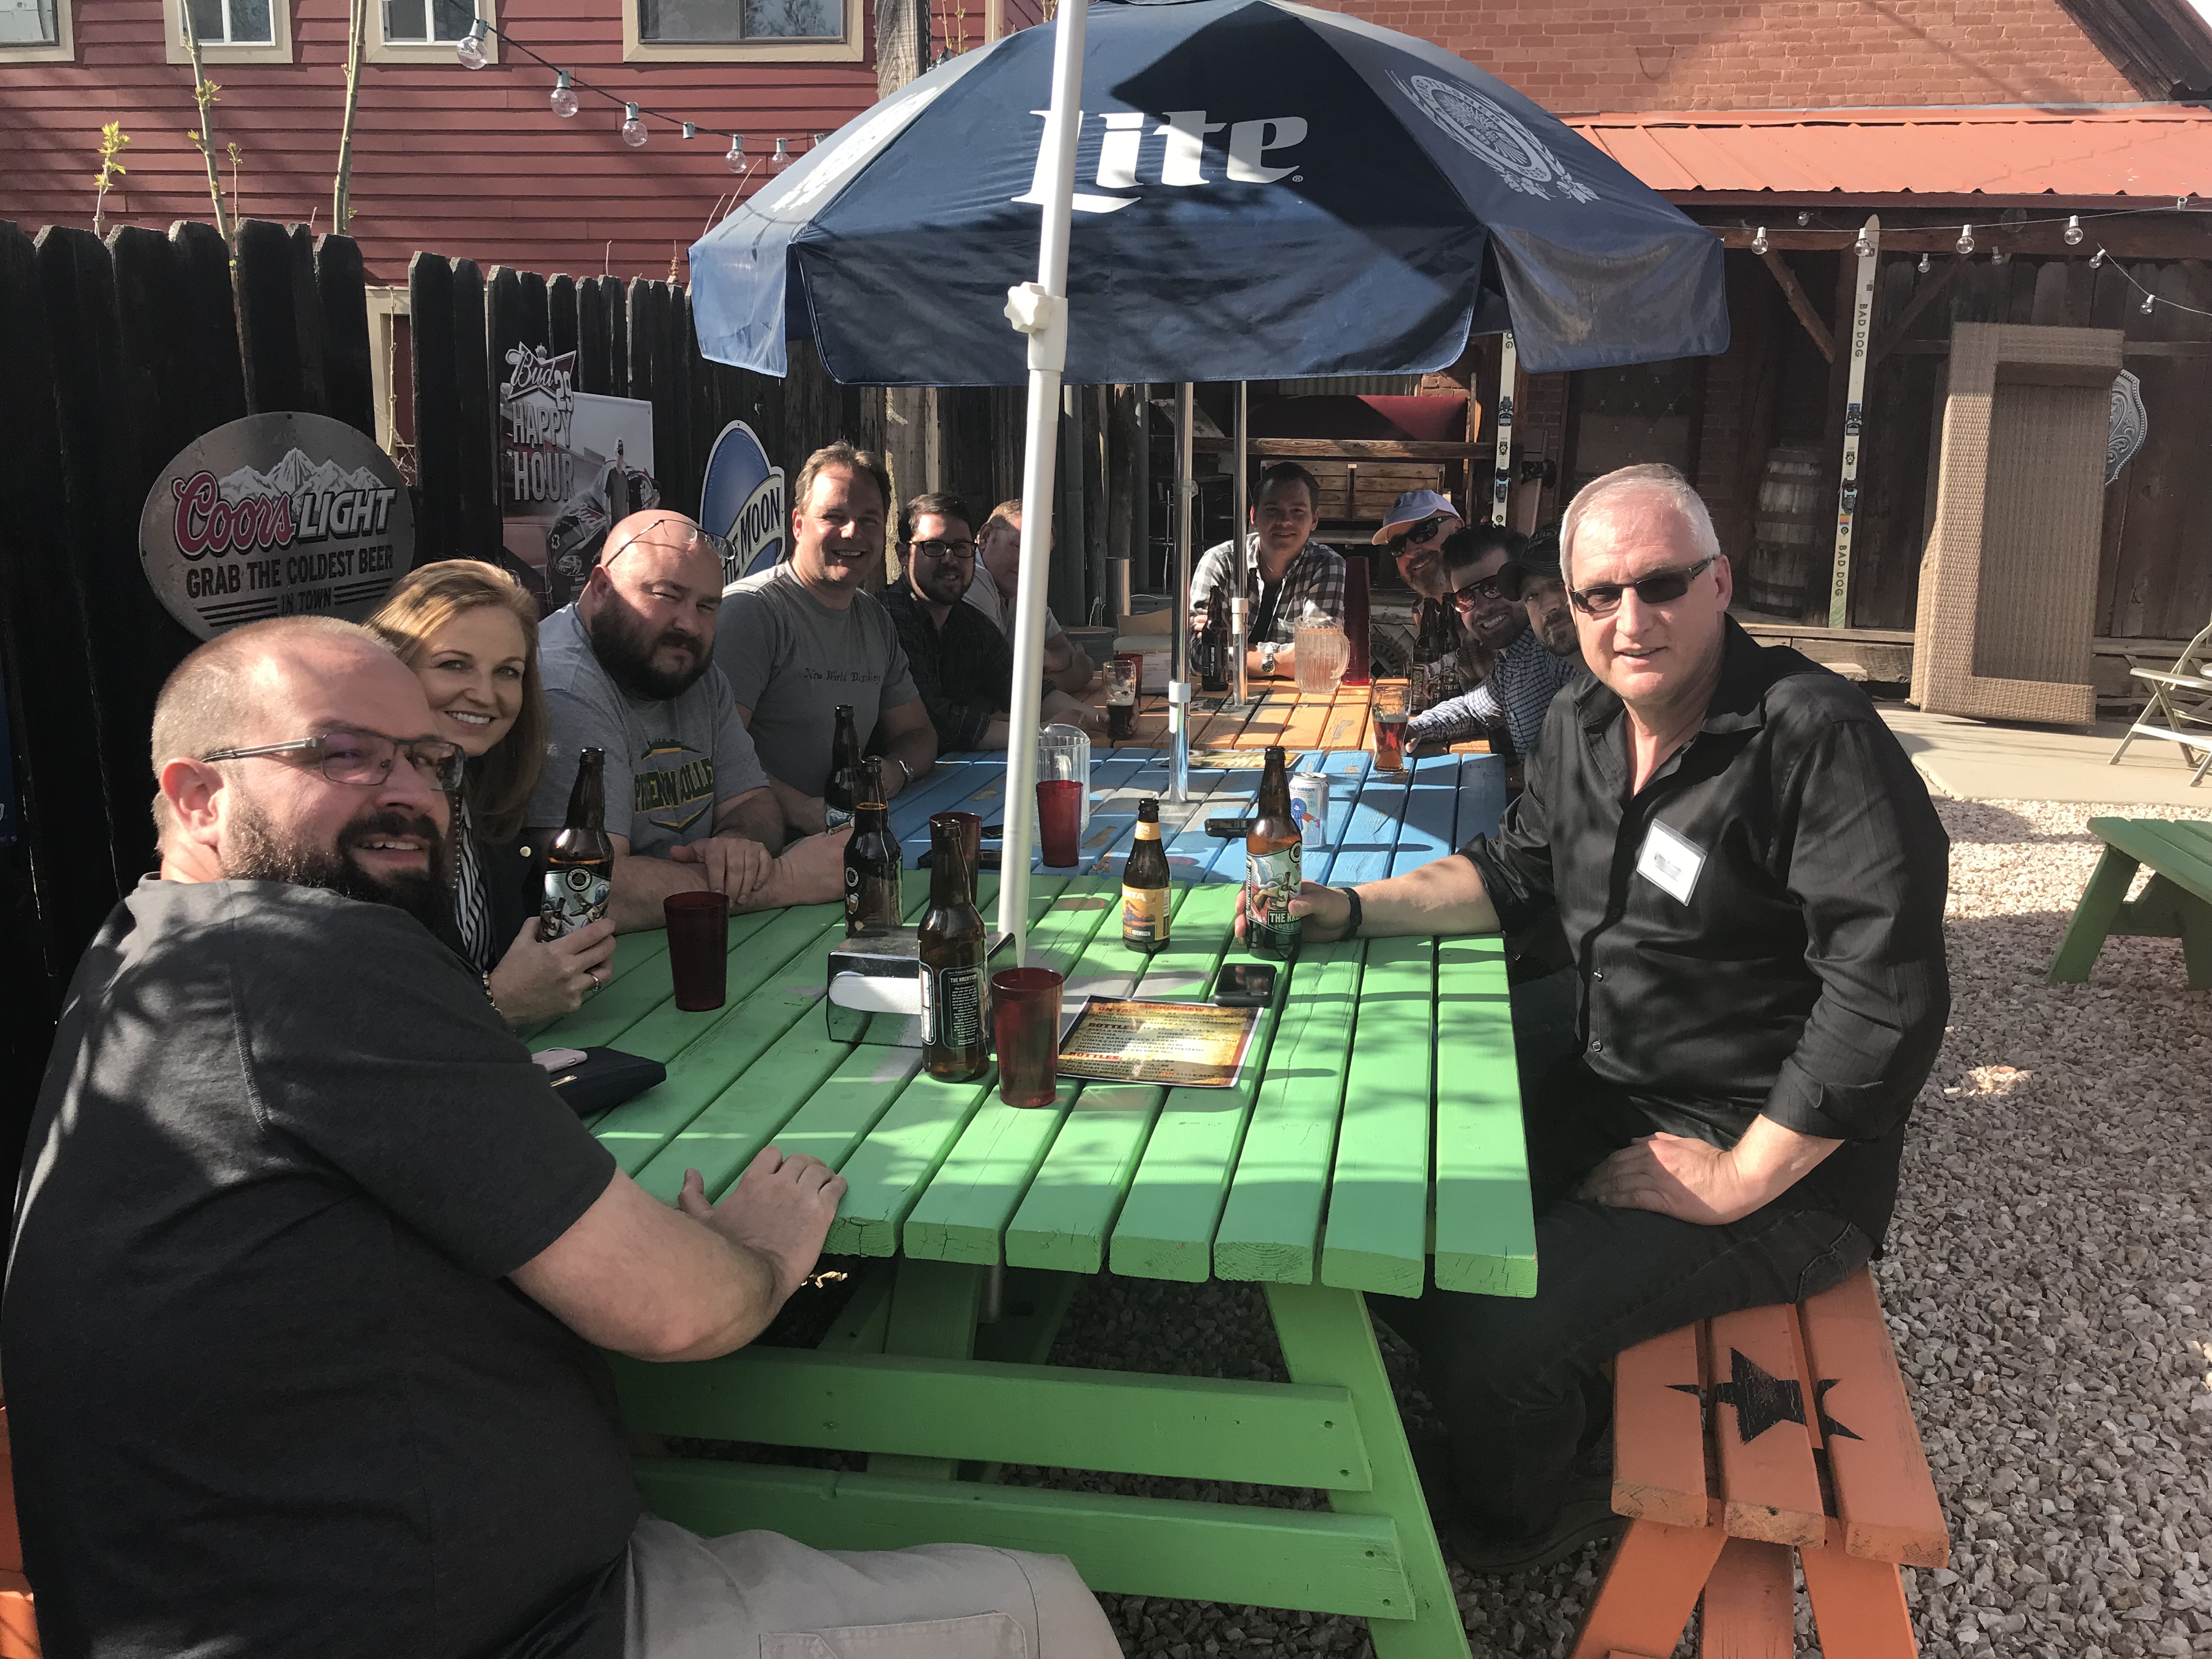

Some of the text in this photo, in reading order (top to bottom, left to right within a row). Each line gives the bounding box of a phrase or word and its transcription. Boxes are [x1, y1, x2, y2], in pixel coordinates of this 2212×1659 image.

[1011, 110, 1308, 213] Lite
[1505, 332, 1514, 349] OG
[1854, 303, 1868, 357] BAD DOG
[505, 348, 574, 412] Bud 29
[512, 402, 572, 449] HAPPY
[514, 452, 575, 501] HOUR
[172, 470, 397, 558] Coors LIGHT
[740, 487, 781, 566] MOON
[187, 544, 394, 599] GRAB THE COLDEST BEER
[1835, 545, 1848, 596] BAD DOG
[281, 588, 332, 614] IN TOWN
[1269, 913, 1286, 923] THE
